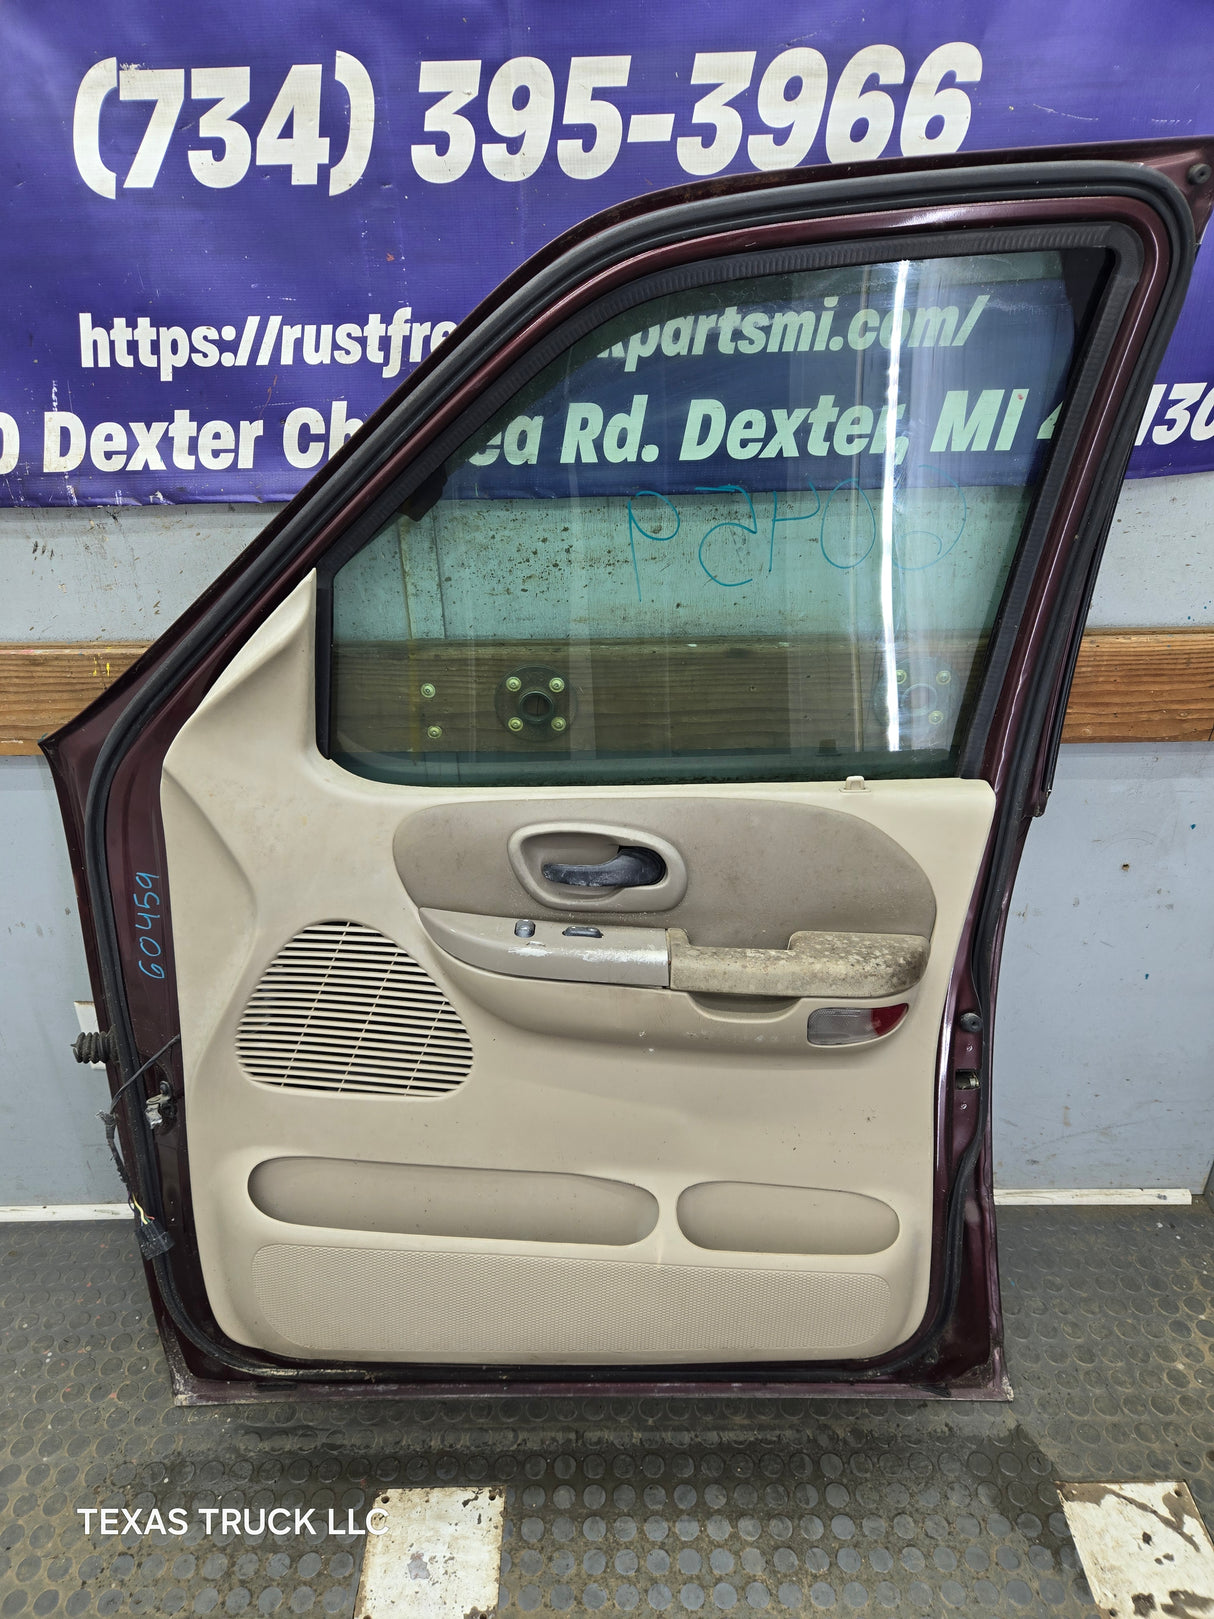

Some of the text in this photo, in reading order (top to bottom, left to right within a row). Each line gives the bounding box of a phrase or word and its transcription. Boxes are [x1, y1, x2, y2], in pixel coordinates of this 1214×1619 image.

[73, 41, 983, 199] (734) 395-3966
[43, 409, 264, 473] Dexter
[560, 394, 660, 464] Rd.
[678, 394, 910, 465] Dexter,
[929, 388, 1030, 453] MI
[133, 871, 165, 979] 60459
